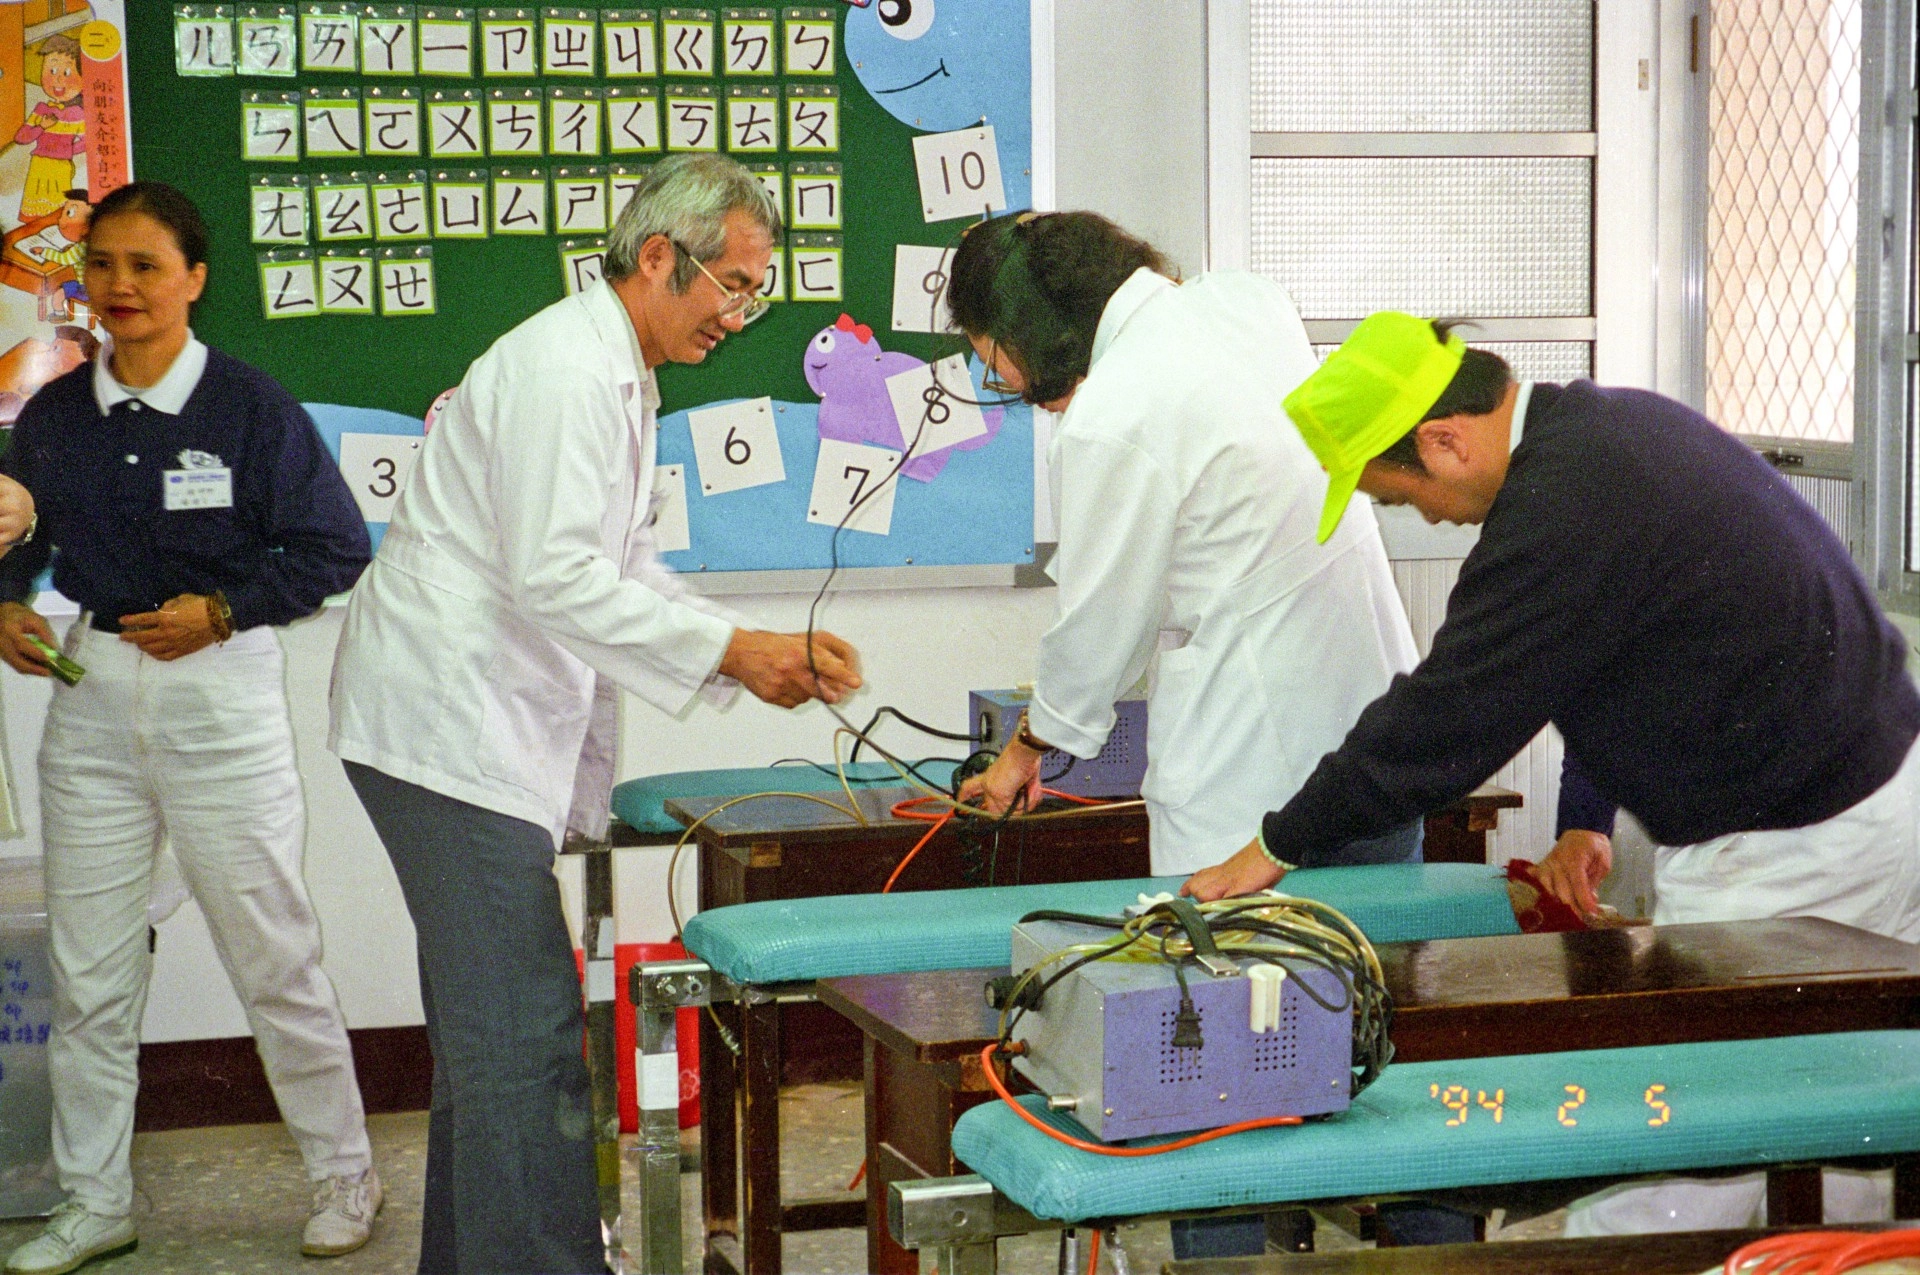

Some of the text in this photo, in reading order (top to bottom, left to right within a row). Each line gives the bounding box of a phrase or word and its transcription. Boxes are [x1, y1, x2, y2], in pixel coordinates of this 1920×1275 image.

[250, 26, 280, 67] ㄢ
[315, 24, 347, 62] ㄞ
[492, 28, 527, 70] ㄗ
[614, 27, 641, 73] ㄐ
[674, 28, 702, 69] ㄍ
[731, 25, 768, 71] ㄉ
[795, 26, 829, 71] ㄅ
[92, 78, 112, 189] 向朋友介紹自己
[255, 111, 291, 152] ㄣ
[373, 111, 412, 149] ㄛ
[497, 105, 534, 149] ㄘ
[623, 102, 645, 147] ㄑ
[673, 104, 713, 146] ㄎ
[795, 102, 827, 146] ㄆ
[941, 152, 984, 194] 10
[381, 189, 420, 234] ㄜ
[564, 185, 596, 226] ㄕ
[921, 387, 951, 424] 8
[725, 427, 750, 465] 6
[369, 458, 396, 497] 3
[843, 466, 869, 505] 7
